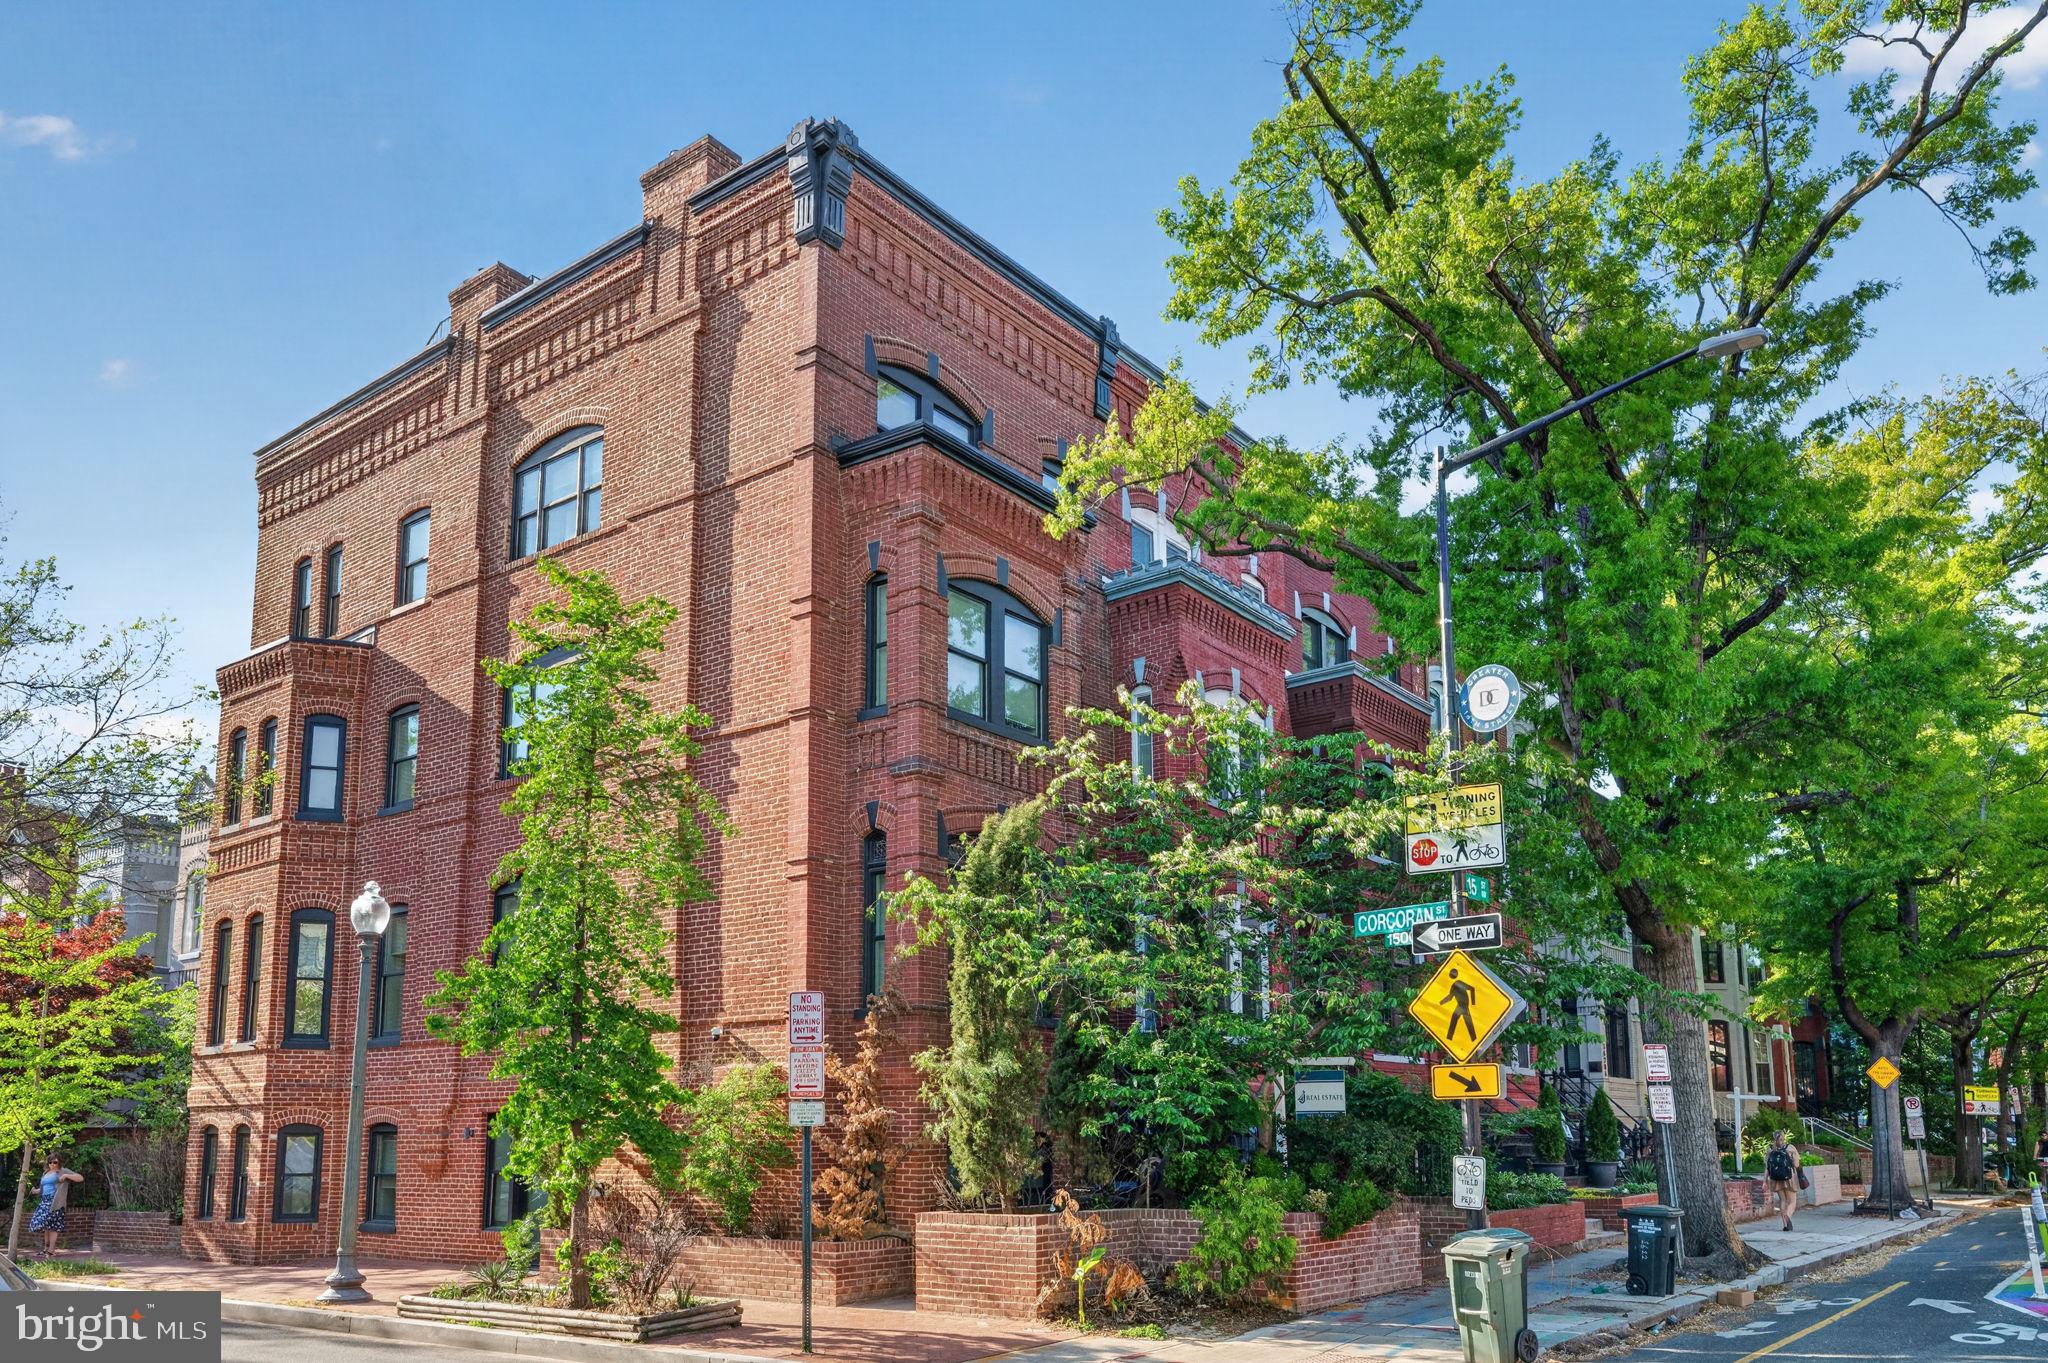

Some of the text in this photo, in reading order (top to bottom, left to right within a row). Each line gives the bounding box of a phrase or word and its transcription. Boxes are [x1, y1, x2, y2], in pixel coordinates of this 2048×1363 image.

[1467, 668, 1509, 686] GREATER
[1480, 689, 1500, 707] DC
[1484, 704, 1515, 729] STREET
[1441, 792, 1496, 807] TNING
[1413, 846, 1453, 864] STOP TO
[1467, 877, 1477, 896] 15
[1358, 905, 1446, 933] CORCORAN ST
[1438, 925, 1491, 942] ONE WAY
[800, 995, 812, 1004] NO
[792, 1004, 821, 1012] STANDING
[792, 1018, 821, 1026] PARKING
[793, 1026, 820, 1034] ANYTIME
[1461, 1179, 1478, 1187] YIELD
[1461, 1195, 1476, 1204] PEDS
